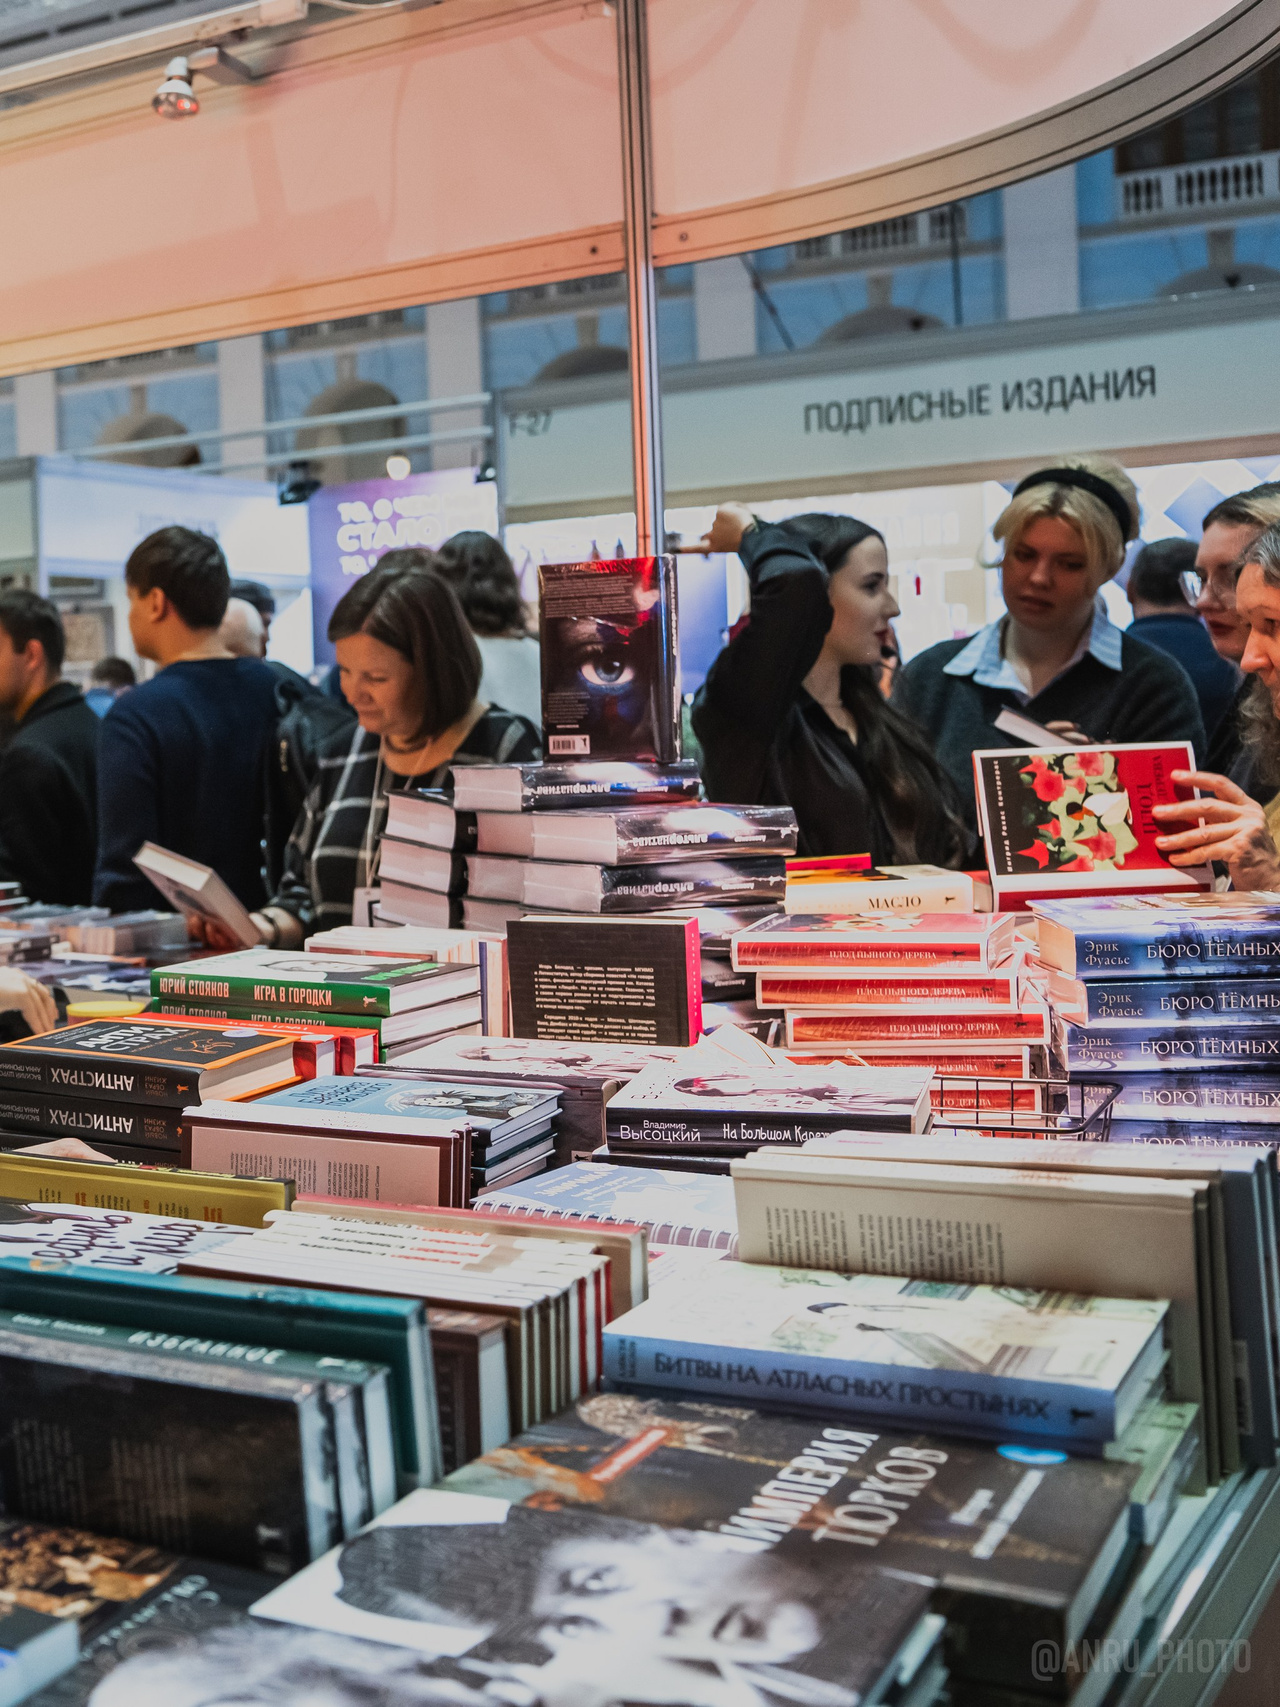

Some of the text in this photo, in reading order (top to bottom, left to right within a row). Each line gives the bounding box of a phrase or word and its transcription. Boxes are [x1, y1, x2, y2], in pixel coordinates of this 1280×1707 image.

[804, 364, 1156, 435] ПОДПИСНЫЕ ИЗДАНИЯ
[337, 516, 441, 552] СТАЛО
[868, 896, 922, 910] МАСЛО
[830, 950, 856, 961] ПЛОД
[902, 951, 937, 961] ДЕРЕВА
[1084, 940, 1119, 953] Эрик
[1147, 943, 1201, 959] БЮРО
[1085, 954, 1131, 968] Фуасье
[159, 976, 332, 1007] ЮРИЙ СТОЯНОВ ИГРА В ГОРОДКИ
[1097, 992, 1132, 1006] Эрик
[1160, 996, 1214, 1011] БЮРО
[1098, 1006, 1144, 1018] Фуасье
[76, 1026, 154, 1048] АНТИ
[964, 1022, 1000, 1033] ДЕРЕВА
[100, 1027, 190, 1051] СТРАХ
[1077, 1035, 1280, 1055] Эрик БЮРО ТЁМНЫХ
[1078, 1048, 1124, 1060] Фуасье
[24, 1065, 41, 1073] АННА
[50, 1067, 135, 1092] АНТИСТРАХ
[1141, 1091, 1198, 1106] БЮРО
[1201, 1088, 1280, 1107] ТЁМНЫХ
[49, 1109, 133, 1134] АНТИСТРАХ
[643, 1119, 687, 1131] Владимир
[620, 1125, 701, 1143] Высоцкий
[723, 1123, 737, 1140] На
[740, 1123, 792, 1142] Большом
[654, 1353, 720, 1378] БИТВЫ
[726, 1364, 761, 1386] НА
[766, 1367, 893, 1401] АТЛАСНЫХ
[898, 1382, 1050, 1420] ПРОСТЫНЯХ
[717, 1427, 880, 1550] ИМПЕРИЯ
[812, 1446, 949, 1547] ТОРКОВ
